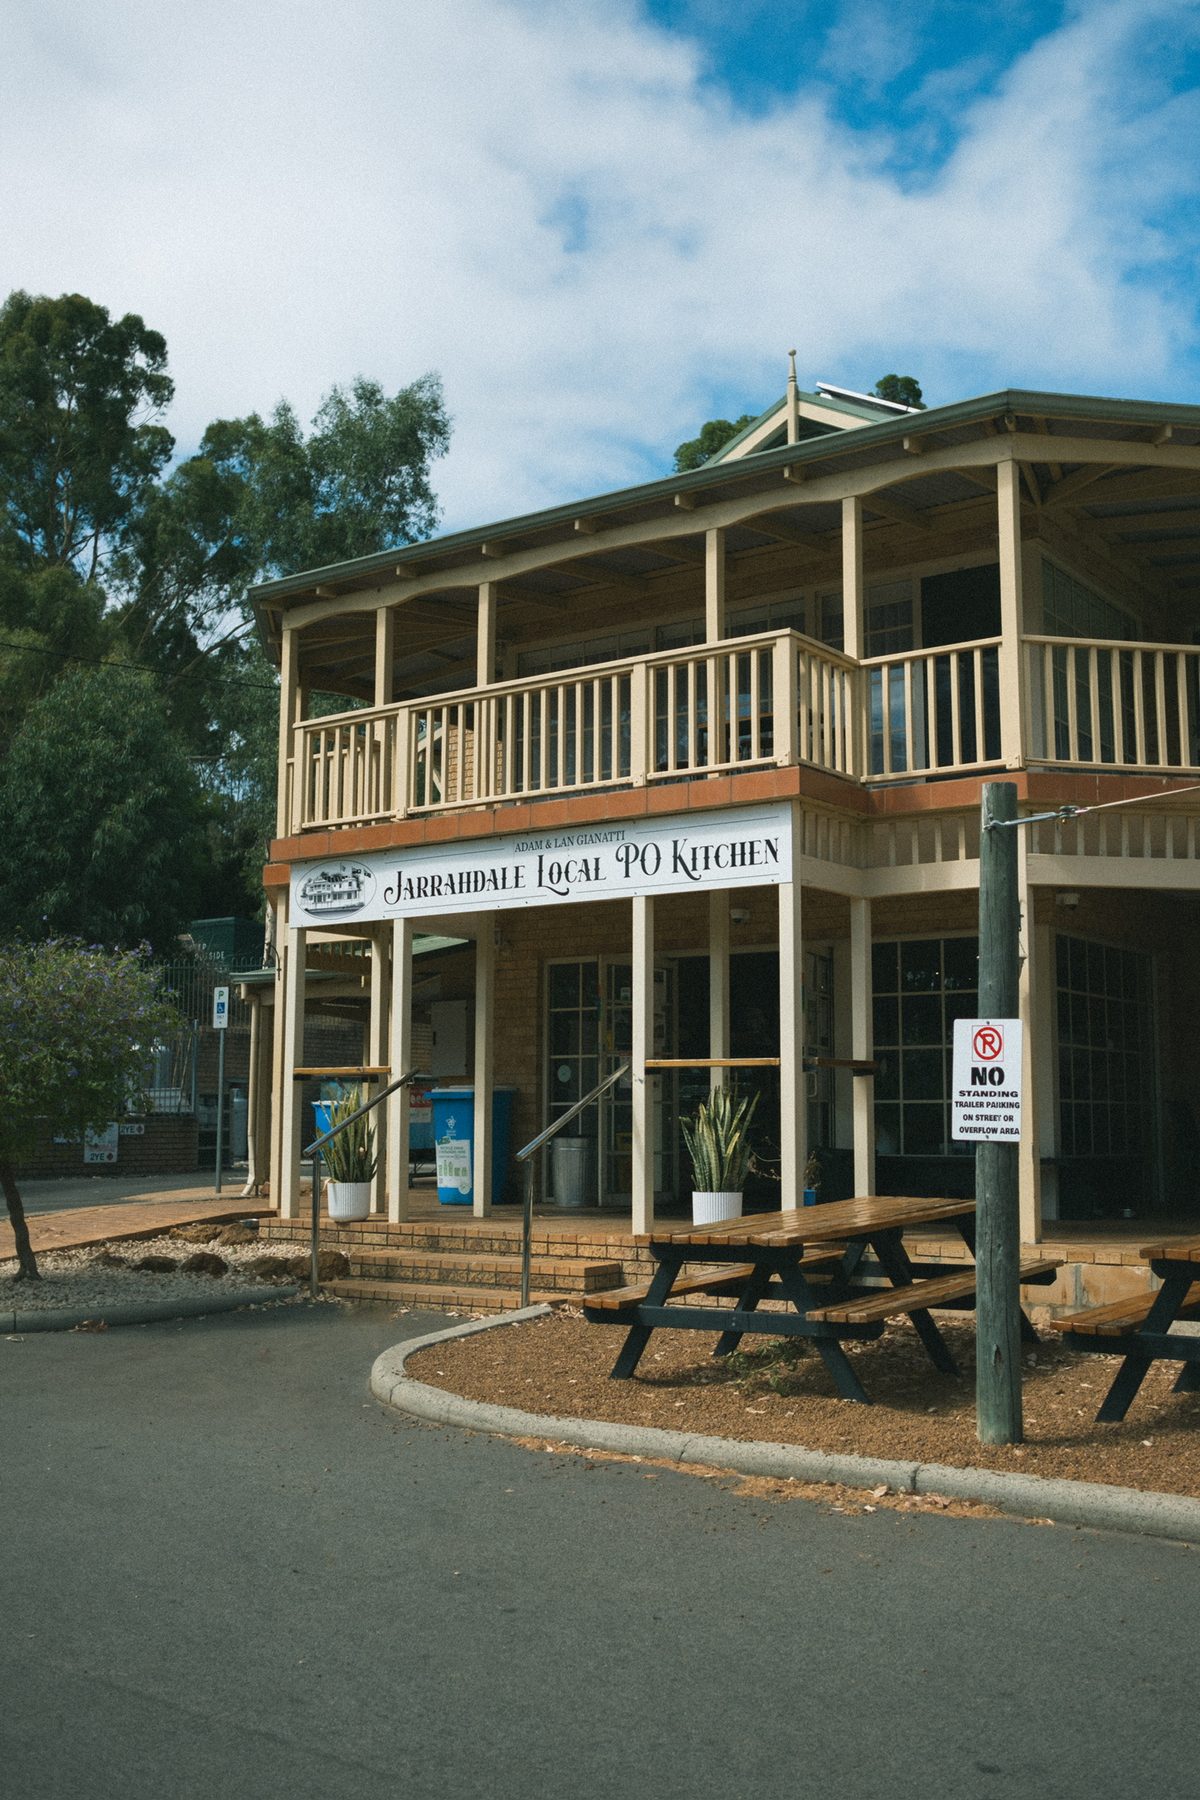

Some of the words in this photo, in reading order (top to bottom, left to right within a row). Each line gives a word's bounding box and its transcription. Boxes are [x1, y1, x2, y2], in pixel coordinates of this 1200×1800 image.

[515, 840, 543, 852] ADAM
[545, 841, 552, 849] &
[554, 834, 575, 848] LAN
[576, 830, 625, 845] GIANATTI
[383, 865, 526, 905] JARRAHDALE
[537, 854, 607, 896] LOCAL
[615, 842, 662, 878] PO
[672, 838, 780, 881] KITCHEN
[970, 1067, 1005, 1086] NO
[986, 1101, 1020, 1109] PARKING
